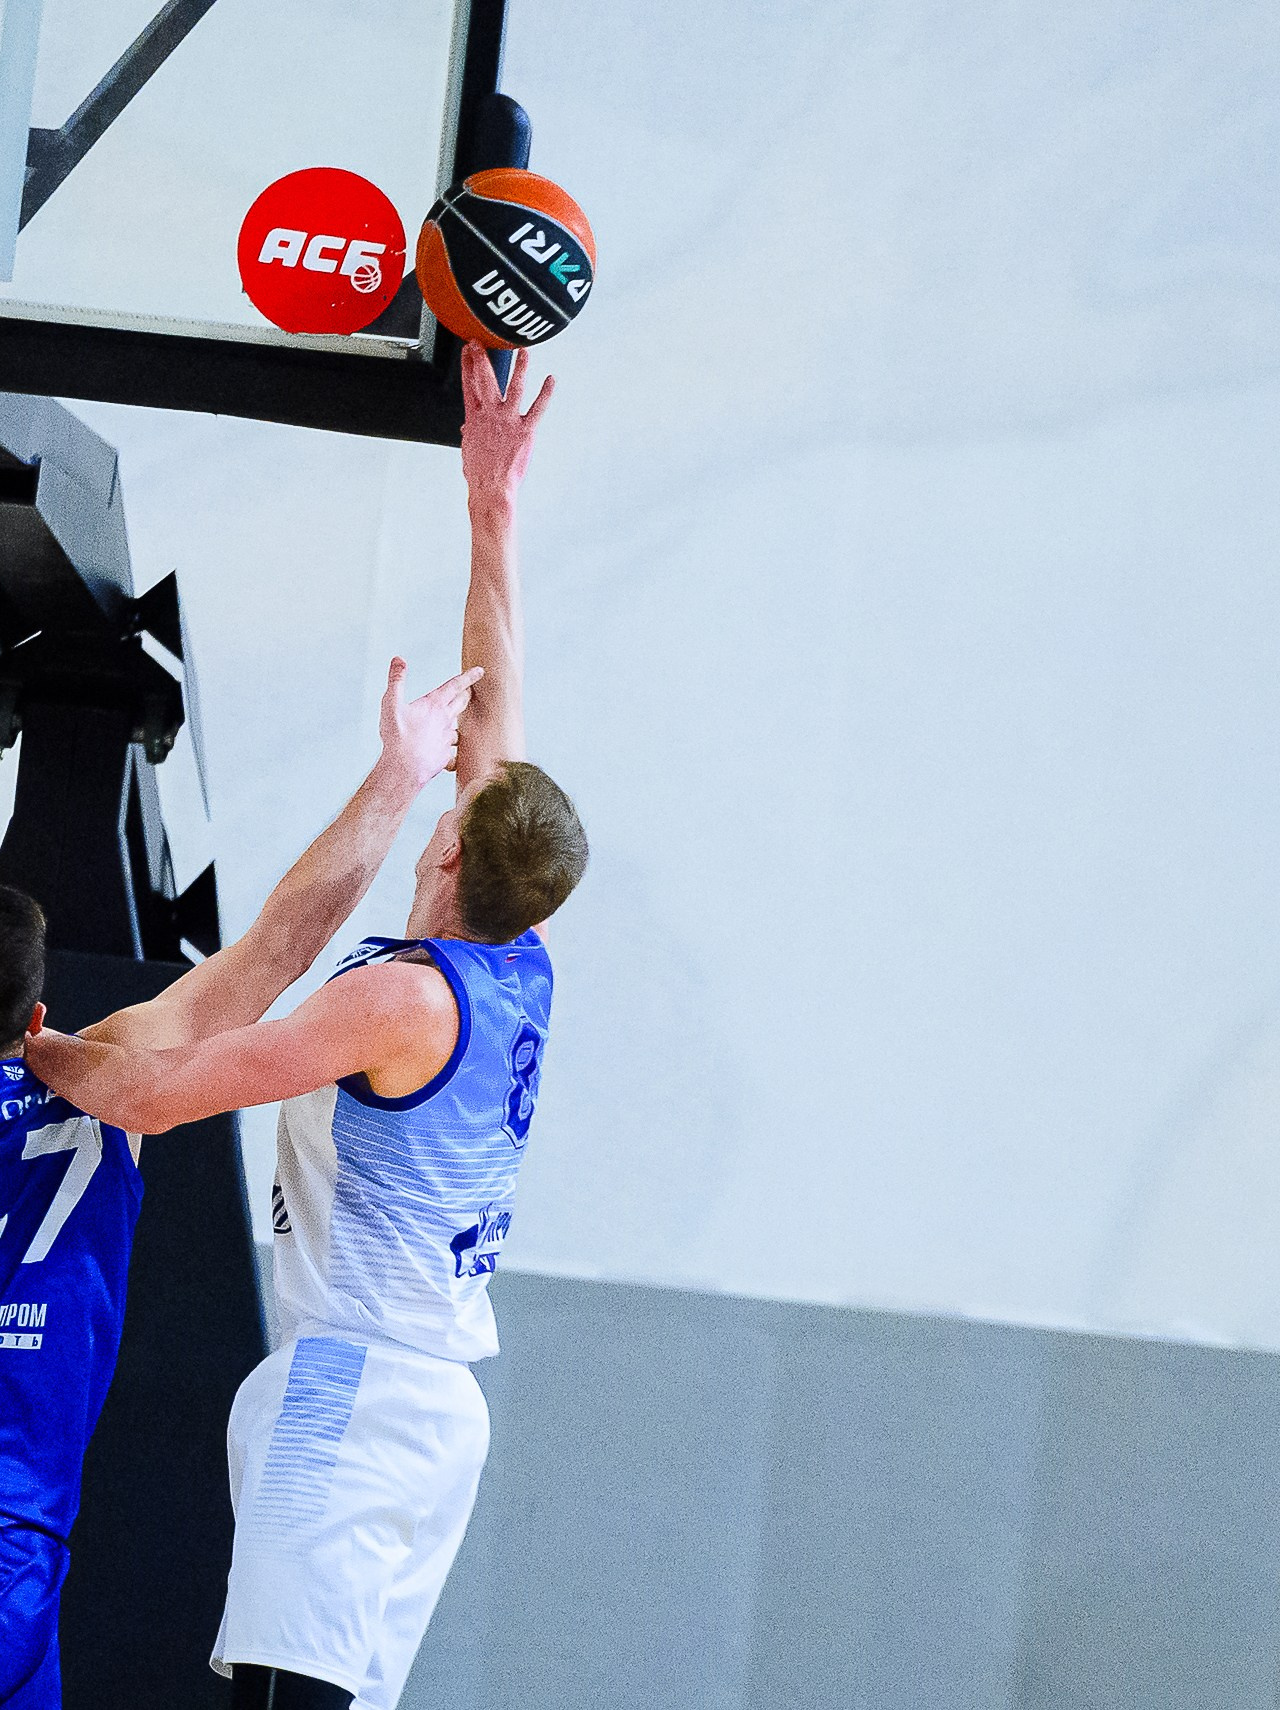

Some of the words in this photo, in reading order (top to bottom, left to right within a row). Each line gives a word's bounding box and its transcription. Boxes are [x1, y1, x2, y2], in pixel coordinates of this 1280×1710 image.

[258, 228, 386, 293] АСБ
[508, 222, 592, 302] PARI
[472, 269, 555, 340] МЛБЛ
